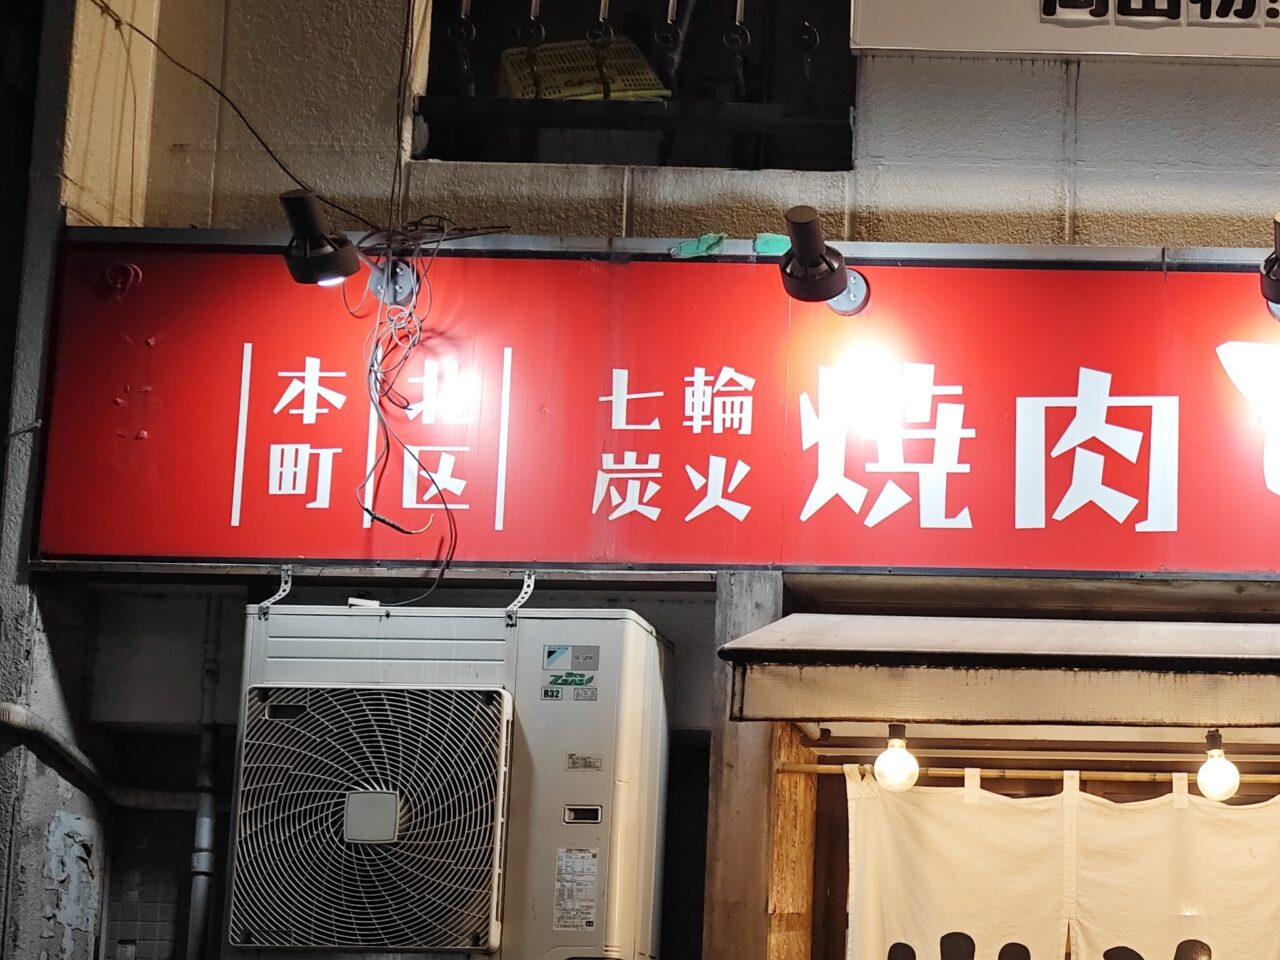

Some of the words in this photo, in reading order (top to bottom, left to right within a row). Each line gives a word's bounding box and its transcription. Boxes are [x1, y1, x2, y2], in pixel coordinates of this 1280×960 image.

[269, 355, 348, 509] 本町
[597, 365, 756, 435] 七輪
[799, 361, 1180, 532] 焼肉
[592, 450, 752, 522] 炭火
[543, 689, 560, 699] R32
